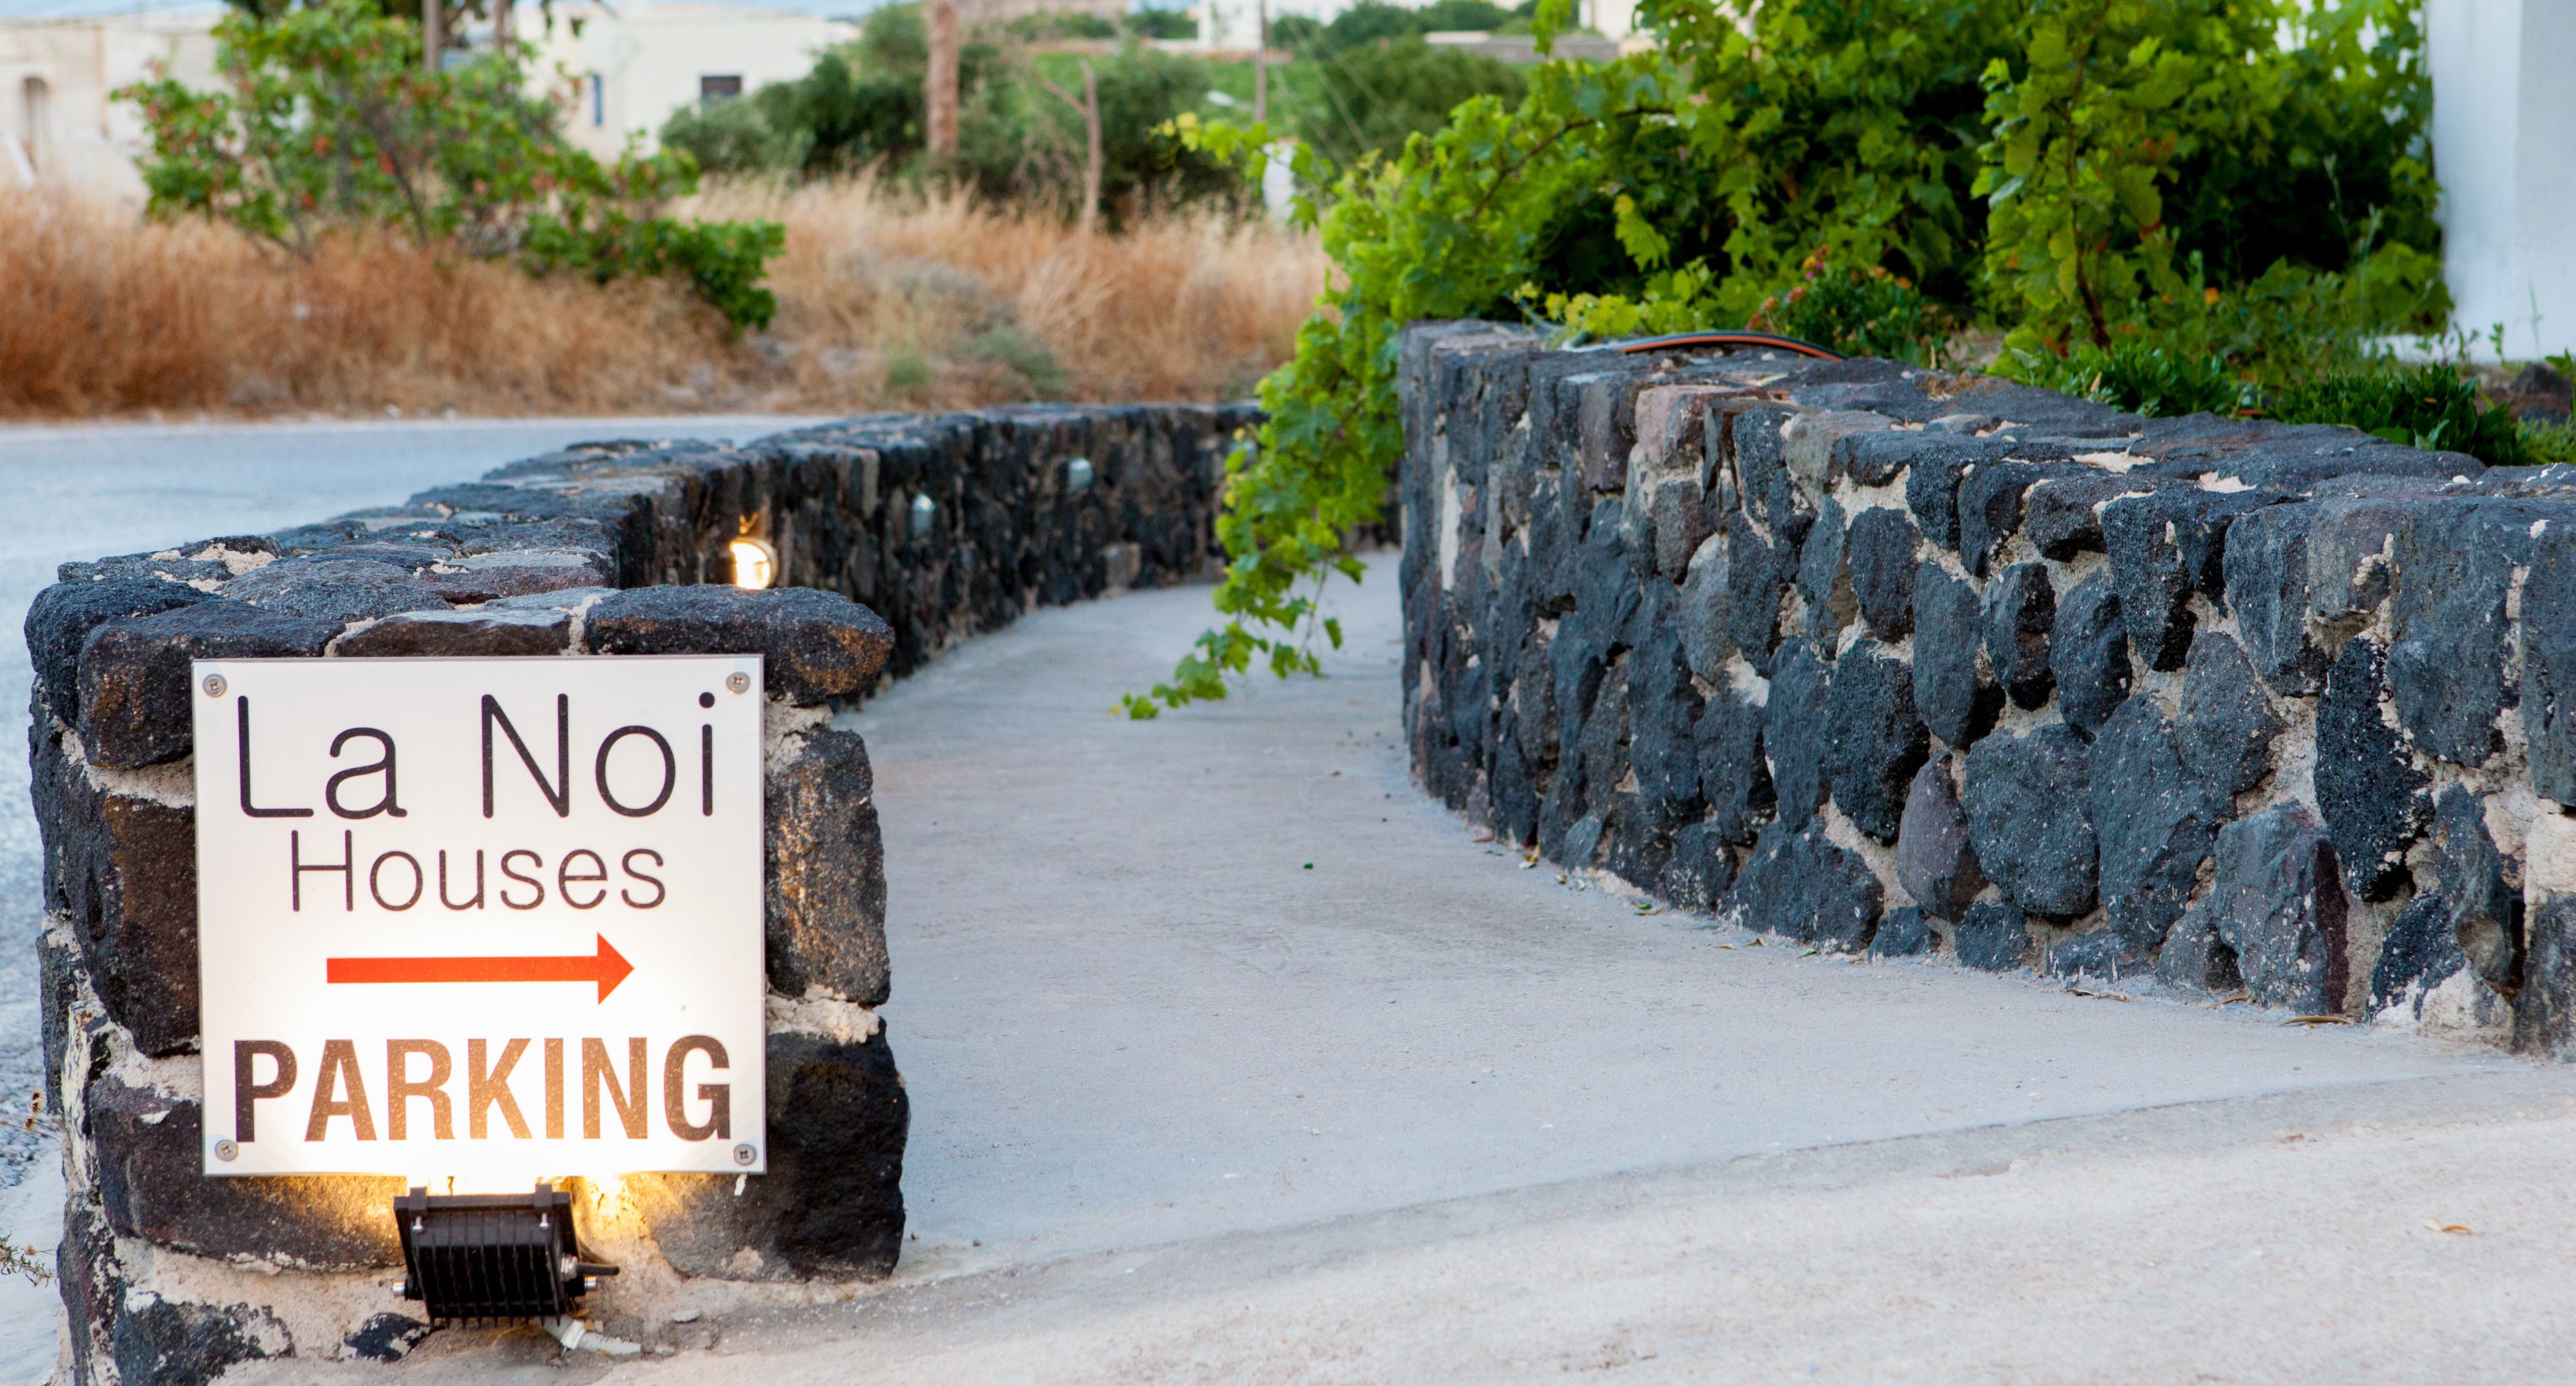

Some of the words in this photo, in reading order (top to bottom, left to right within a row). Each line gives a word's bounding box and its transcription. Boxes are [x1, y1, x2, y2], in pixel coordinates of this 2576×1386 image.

[237, 695, 407, 820] La
[481, 692, 716, 818] Noi
[291, 829, 665, 912] Houses
[233, 1034, 732, 1143] PARKING
